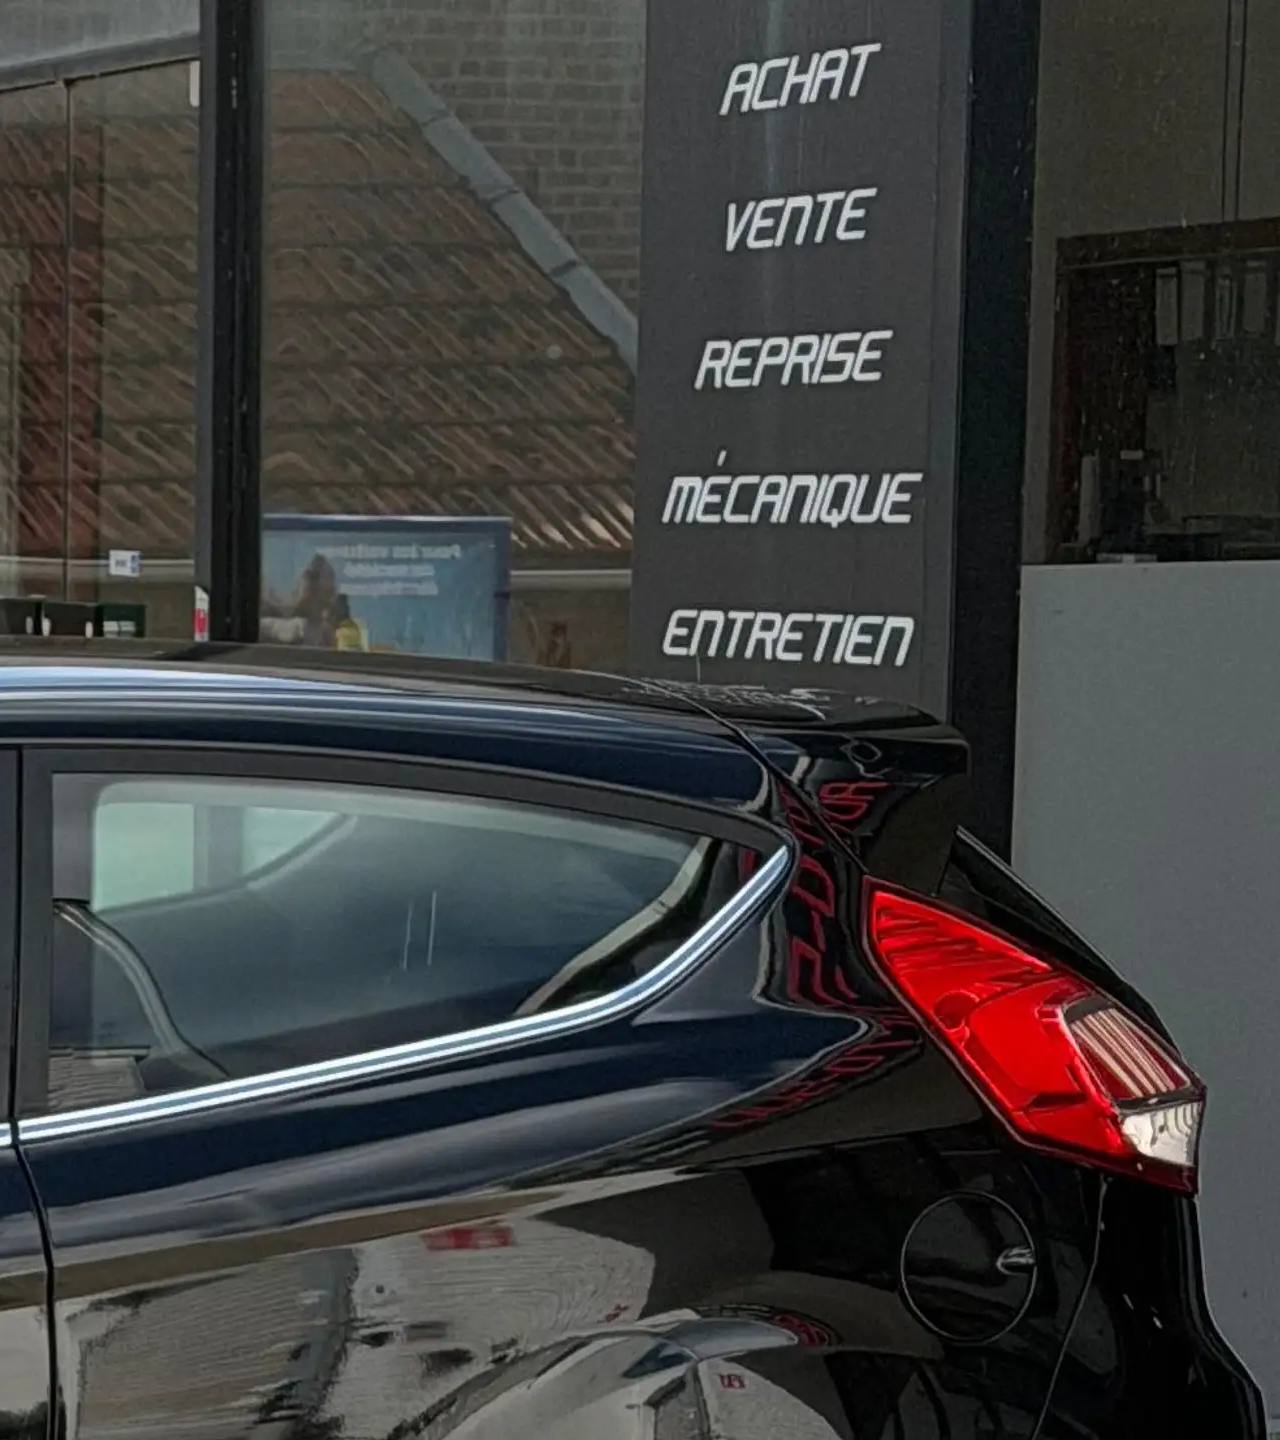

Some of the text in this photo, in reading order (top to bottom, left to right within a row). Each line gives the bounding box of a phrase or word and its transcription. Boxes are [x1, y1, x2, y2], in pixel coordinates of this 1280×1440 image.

[720, 43, 881, 115] ACHAT
[726, 188, 877, 251] VENTE
[695, 330, 893, 389] REPRISE
[662, 451, 922, 527] MÉCANIQUE
[663, 610, 914, 665] ENTRETIEN
